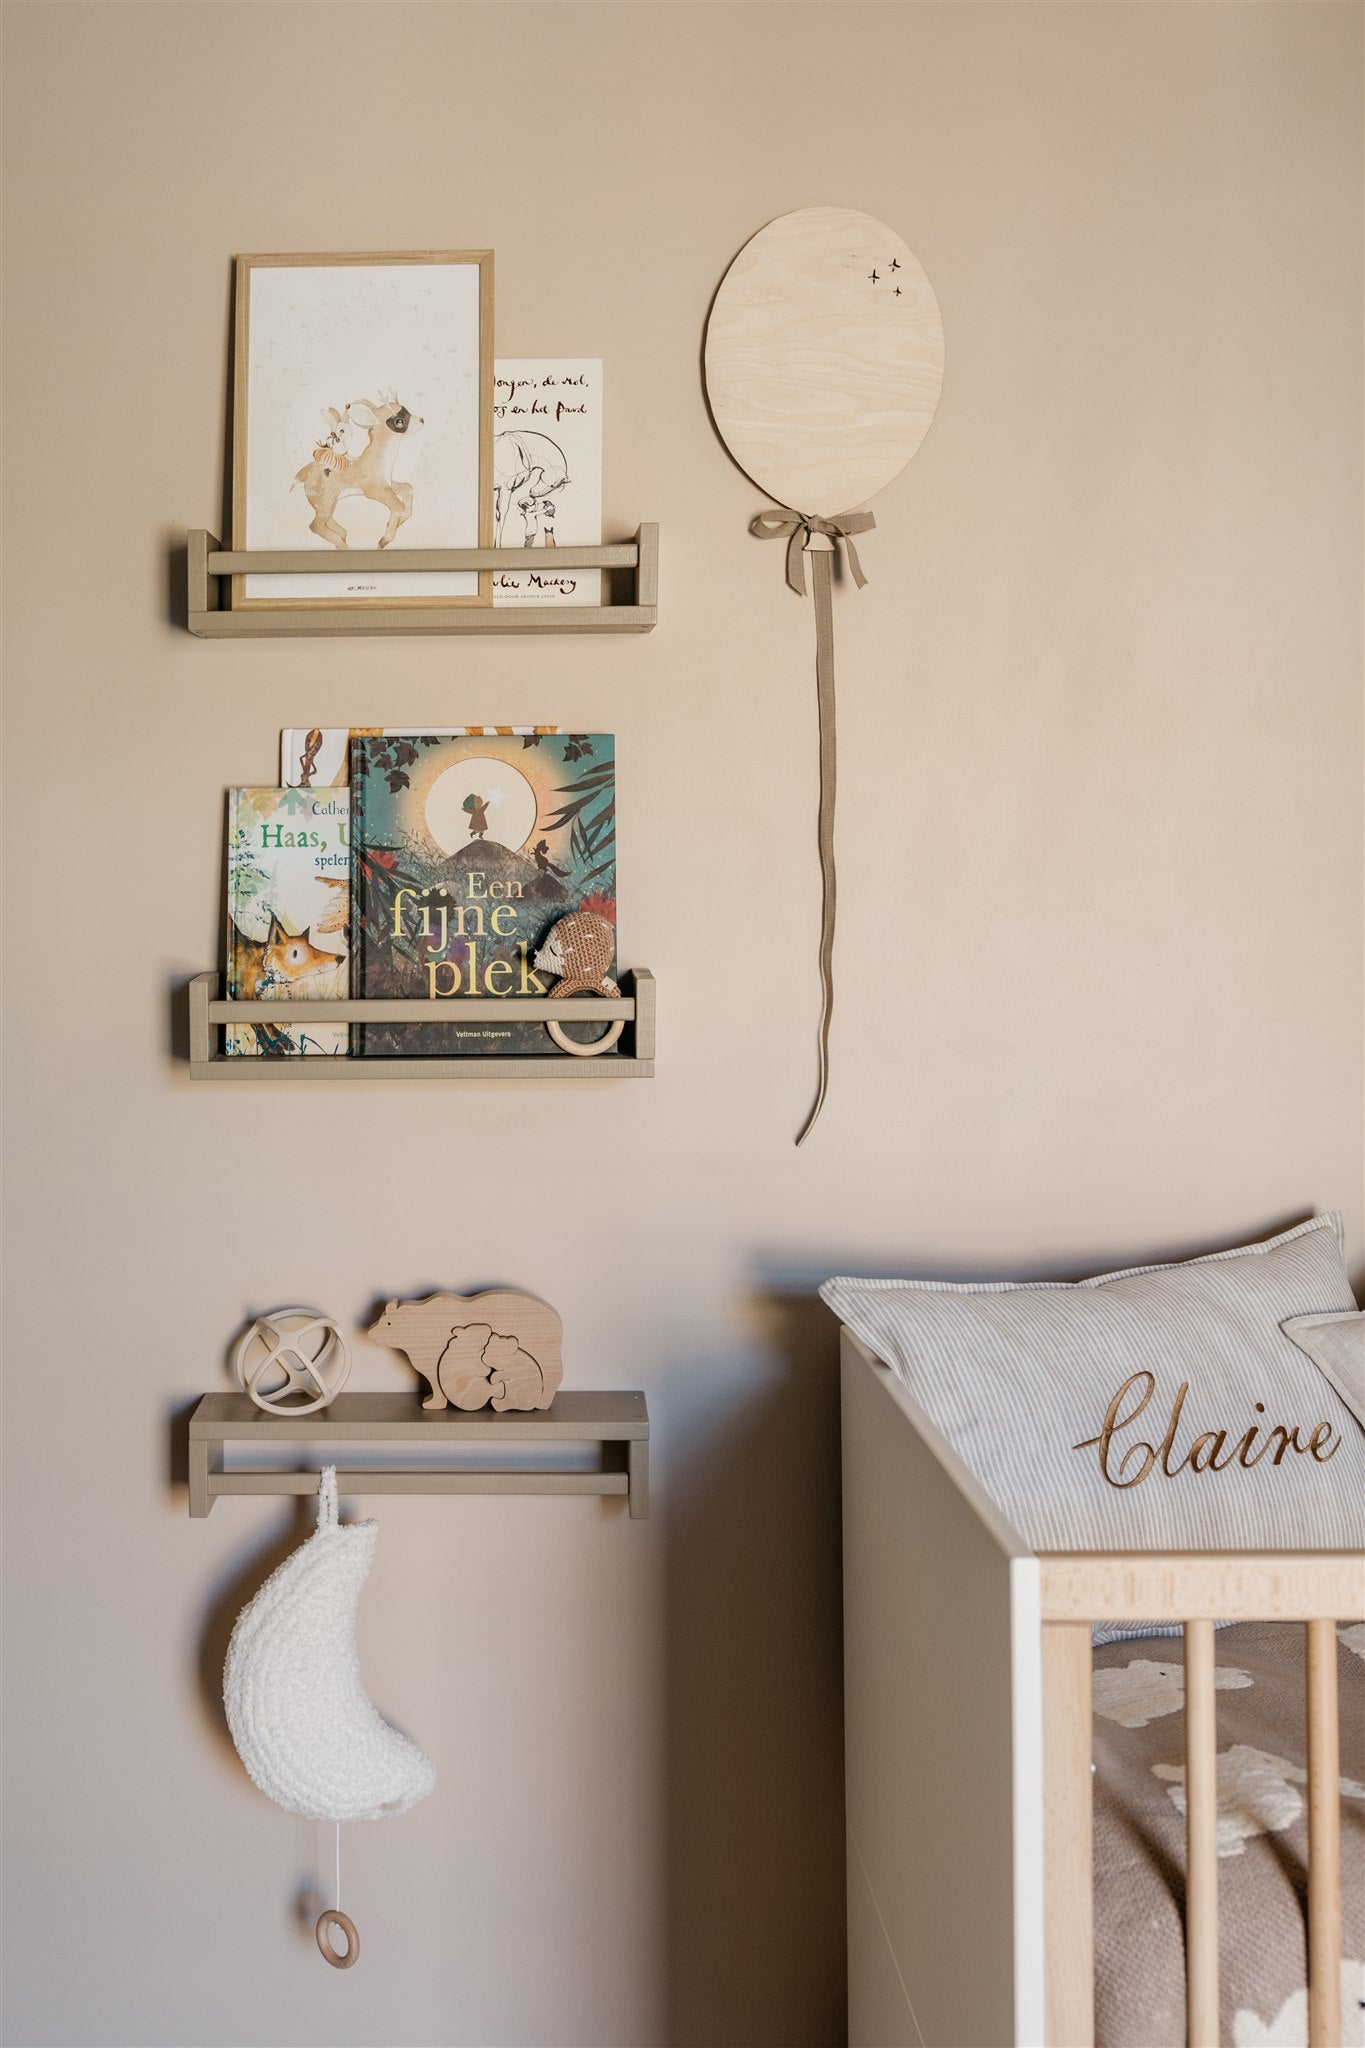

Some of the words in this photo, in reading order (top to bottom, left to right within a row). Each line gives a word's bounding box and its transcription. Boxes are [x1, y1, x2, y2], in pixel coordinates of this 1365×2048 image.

[542, 375, 559, 386] de
[511, 406, 528, 414] en
[531, 399, 549, 415] het
[493, 574, 520, 588] rlie
[312, 801, 351, 815] Cather
[261, 824, 327, 852] Haas,
[466, 872, 524, 898] Een
[390, 888, 517, 953] fijne
[424, 941, 549, 999] plek
[482, 1031, 511, 1039] Uitgevers
[1072, 1370, 1342, 1489] Claire
